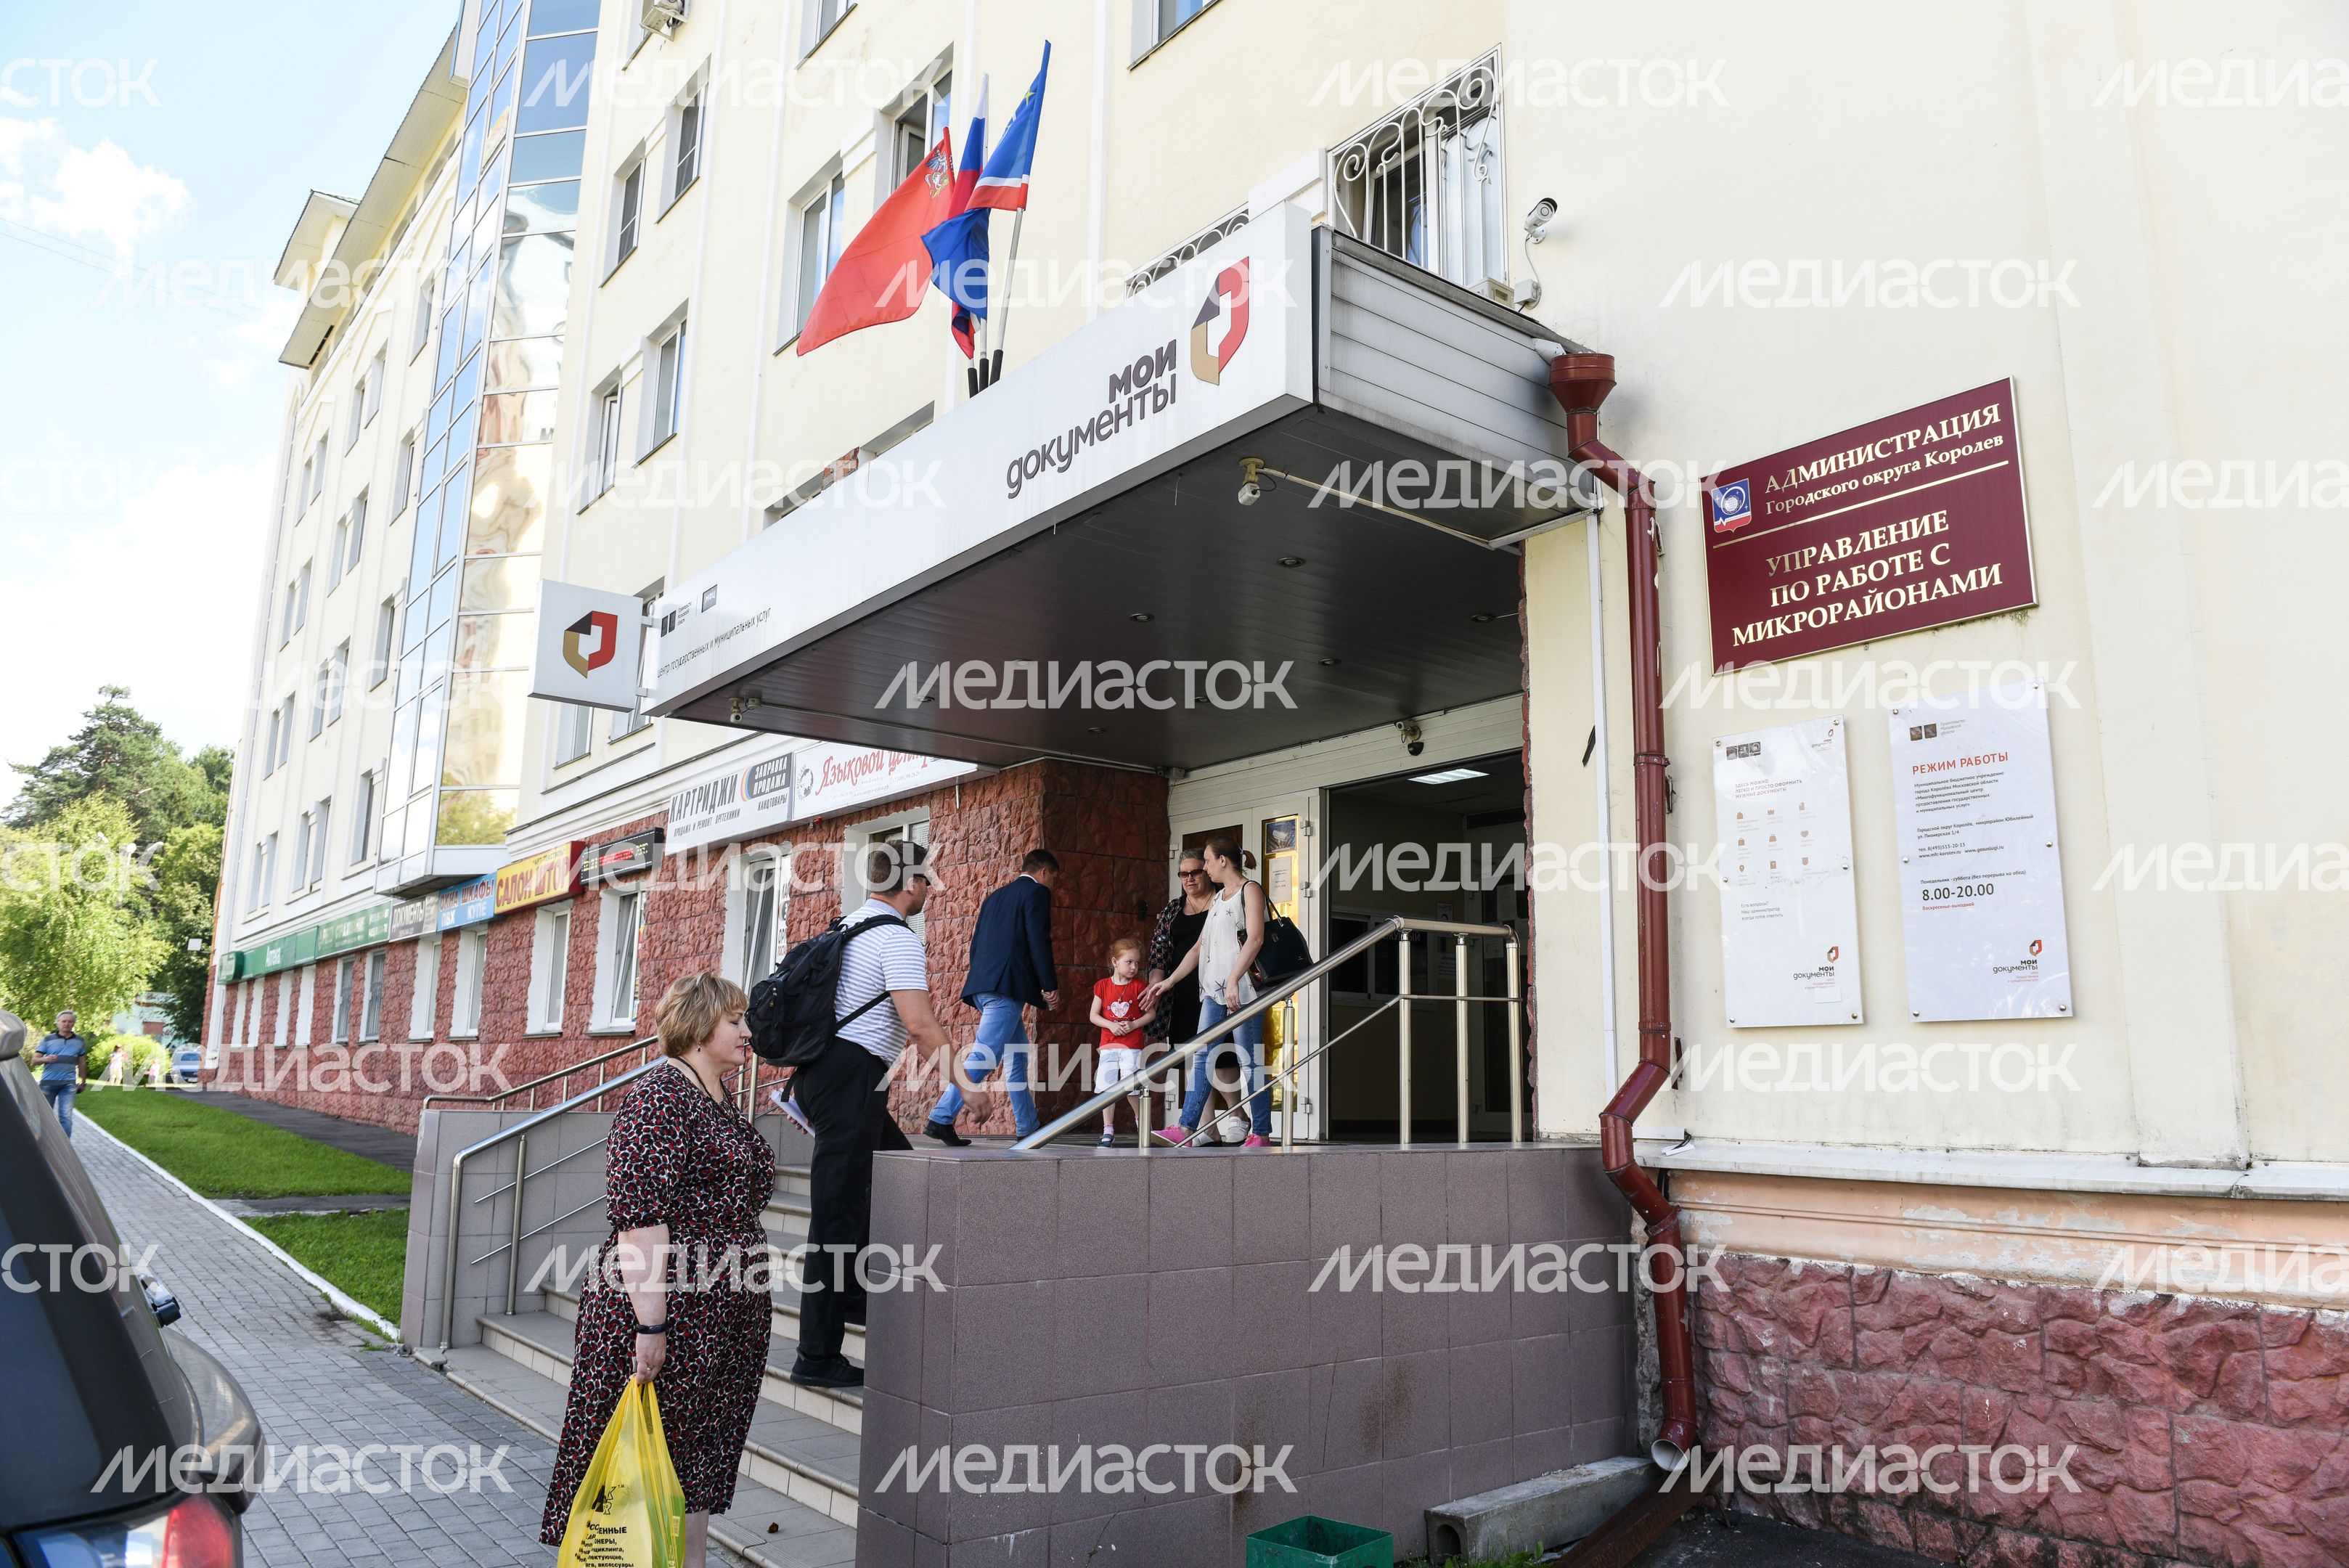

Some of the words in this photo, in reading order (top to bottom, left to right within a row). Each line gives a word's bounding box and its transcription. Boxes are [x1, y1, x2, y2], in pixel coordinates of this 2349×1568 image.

[1765, 404, 2001, 494] АДМИНИСТРАЦИЯ
[1765, 478, 1858, 515] Городского
[1863, 460, 1921, 485] округа
[1925, 435, 2003, 467] Королев
[1766, 510, 1949, 576] УПРАВЛЕНИЕ
[1770, 580, 1810, 607] ПО
[1816, 550, 1924, 596] РАБОТЕ
[1931, 542, 1950, 565] С
[1733, 563, 2003, 646] МИКРОРАЙОНАМИ
[658, 664, 670, 678] центр
[714, 616, 755, 649] муниципальных
[756, 608, 771, 627] услуг
[755, 756, 788, 780] ЗАПРАВКА
[1912, 760, 1956, 775] РЕЖИМ
[1960, 752, 2009, 768] РАБОТЫ
[669, 774, 738, 824] КАРТРИДЖИ
[753, 772, 785, 796] ПРОДАЖА
[758, 793, 788, 812] КАНЦТОВАРЫ
[674, 824, 691, 837] ПРОДАЖА
[693, 822, 696, 831] И
[697, 817, 713, 830] РЕМОНТ
[715, 808, 740, 824] ОРГТЕХНИКИ
[441, 890, 458, 910] ОКНА
[461, 879, 494, 905] ШКАФЫ
[496, 868, 534, 907] САЛОН
[535, 857, 570, 896] ШТОР
[1922, 883, 1994, 901] 8.00-20.00
[441, 910, 456, 927] ПВХ
[467, 902, 487, 920] КУПЕ
